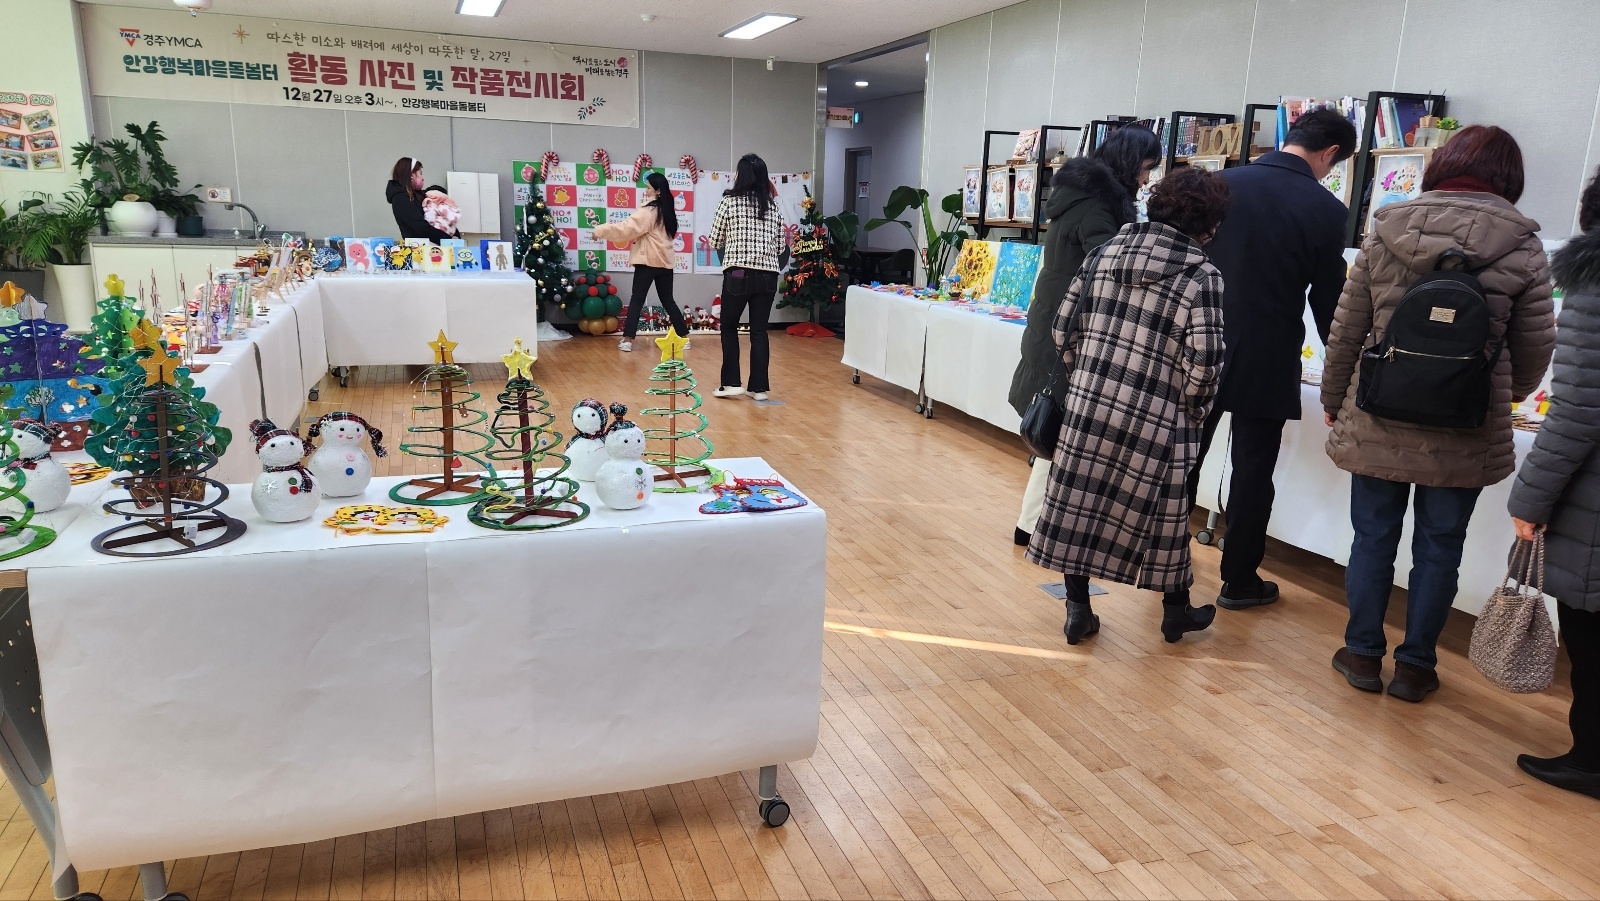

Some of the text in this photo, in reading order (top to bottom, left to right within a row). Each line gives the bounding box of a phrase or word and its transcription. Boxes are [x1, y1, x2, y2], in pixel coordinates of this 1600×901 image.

[119, 30, 141, 40] YMCA
[143, 33, 203, 48] 경주YMCA
[266, 31, 511, 64] 따스한 미소와 배려에 세상이 따뜻한 달, 27일
[122, 51, 585, 102] 안강행복마을돌봄터 활동 사진 및 작품전시회
[282, 86, 311, 102] 12월
[313, 88, 343, 104] 27일
[344, 94, 363, 105] 오후
[401, 97, 486, 113] 안강행복마을돌봄터
[611, 168, 624, 176] HO
[615, 175, 631, 183] HO!
[552, 209, 565, 217] HO
[556, 216, 573, 225] HO!
